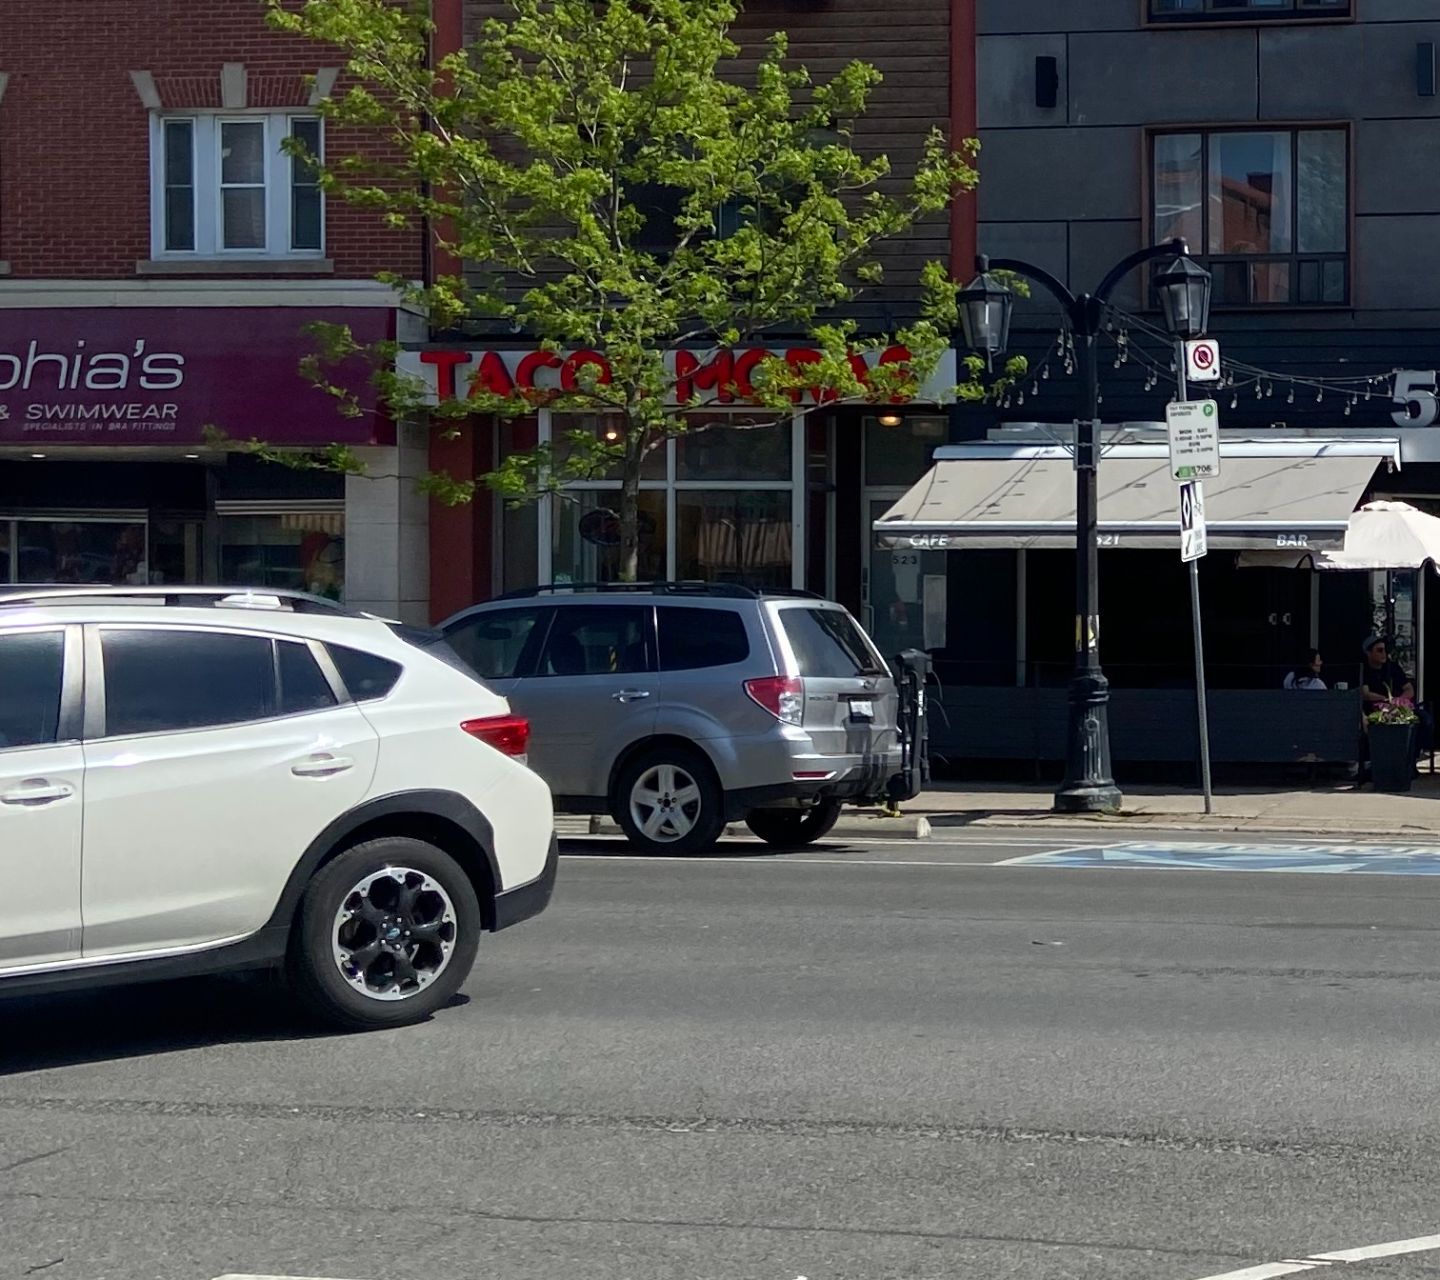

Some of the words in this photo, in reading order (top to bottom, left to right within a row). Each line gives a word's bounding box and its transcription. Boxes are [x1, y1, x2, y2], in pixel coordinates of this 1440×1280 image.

[420, 351, 614, 408] TACO
[25, 403, 178, 420] SWIMWEAR
[909, 534, 949, 547] CAFE
[1276, 534, 1308, 547] BAR
